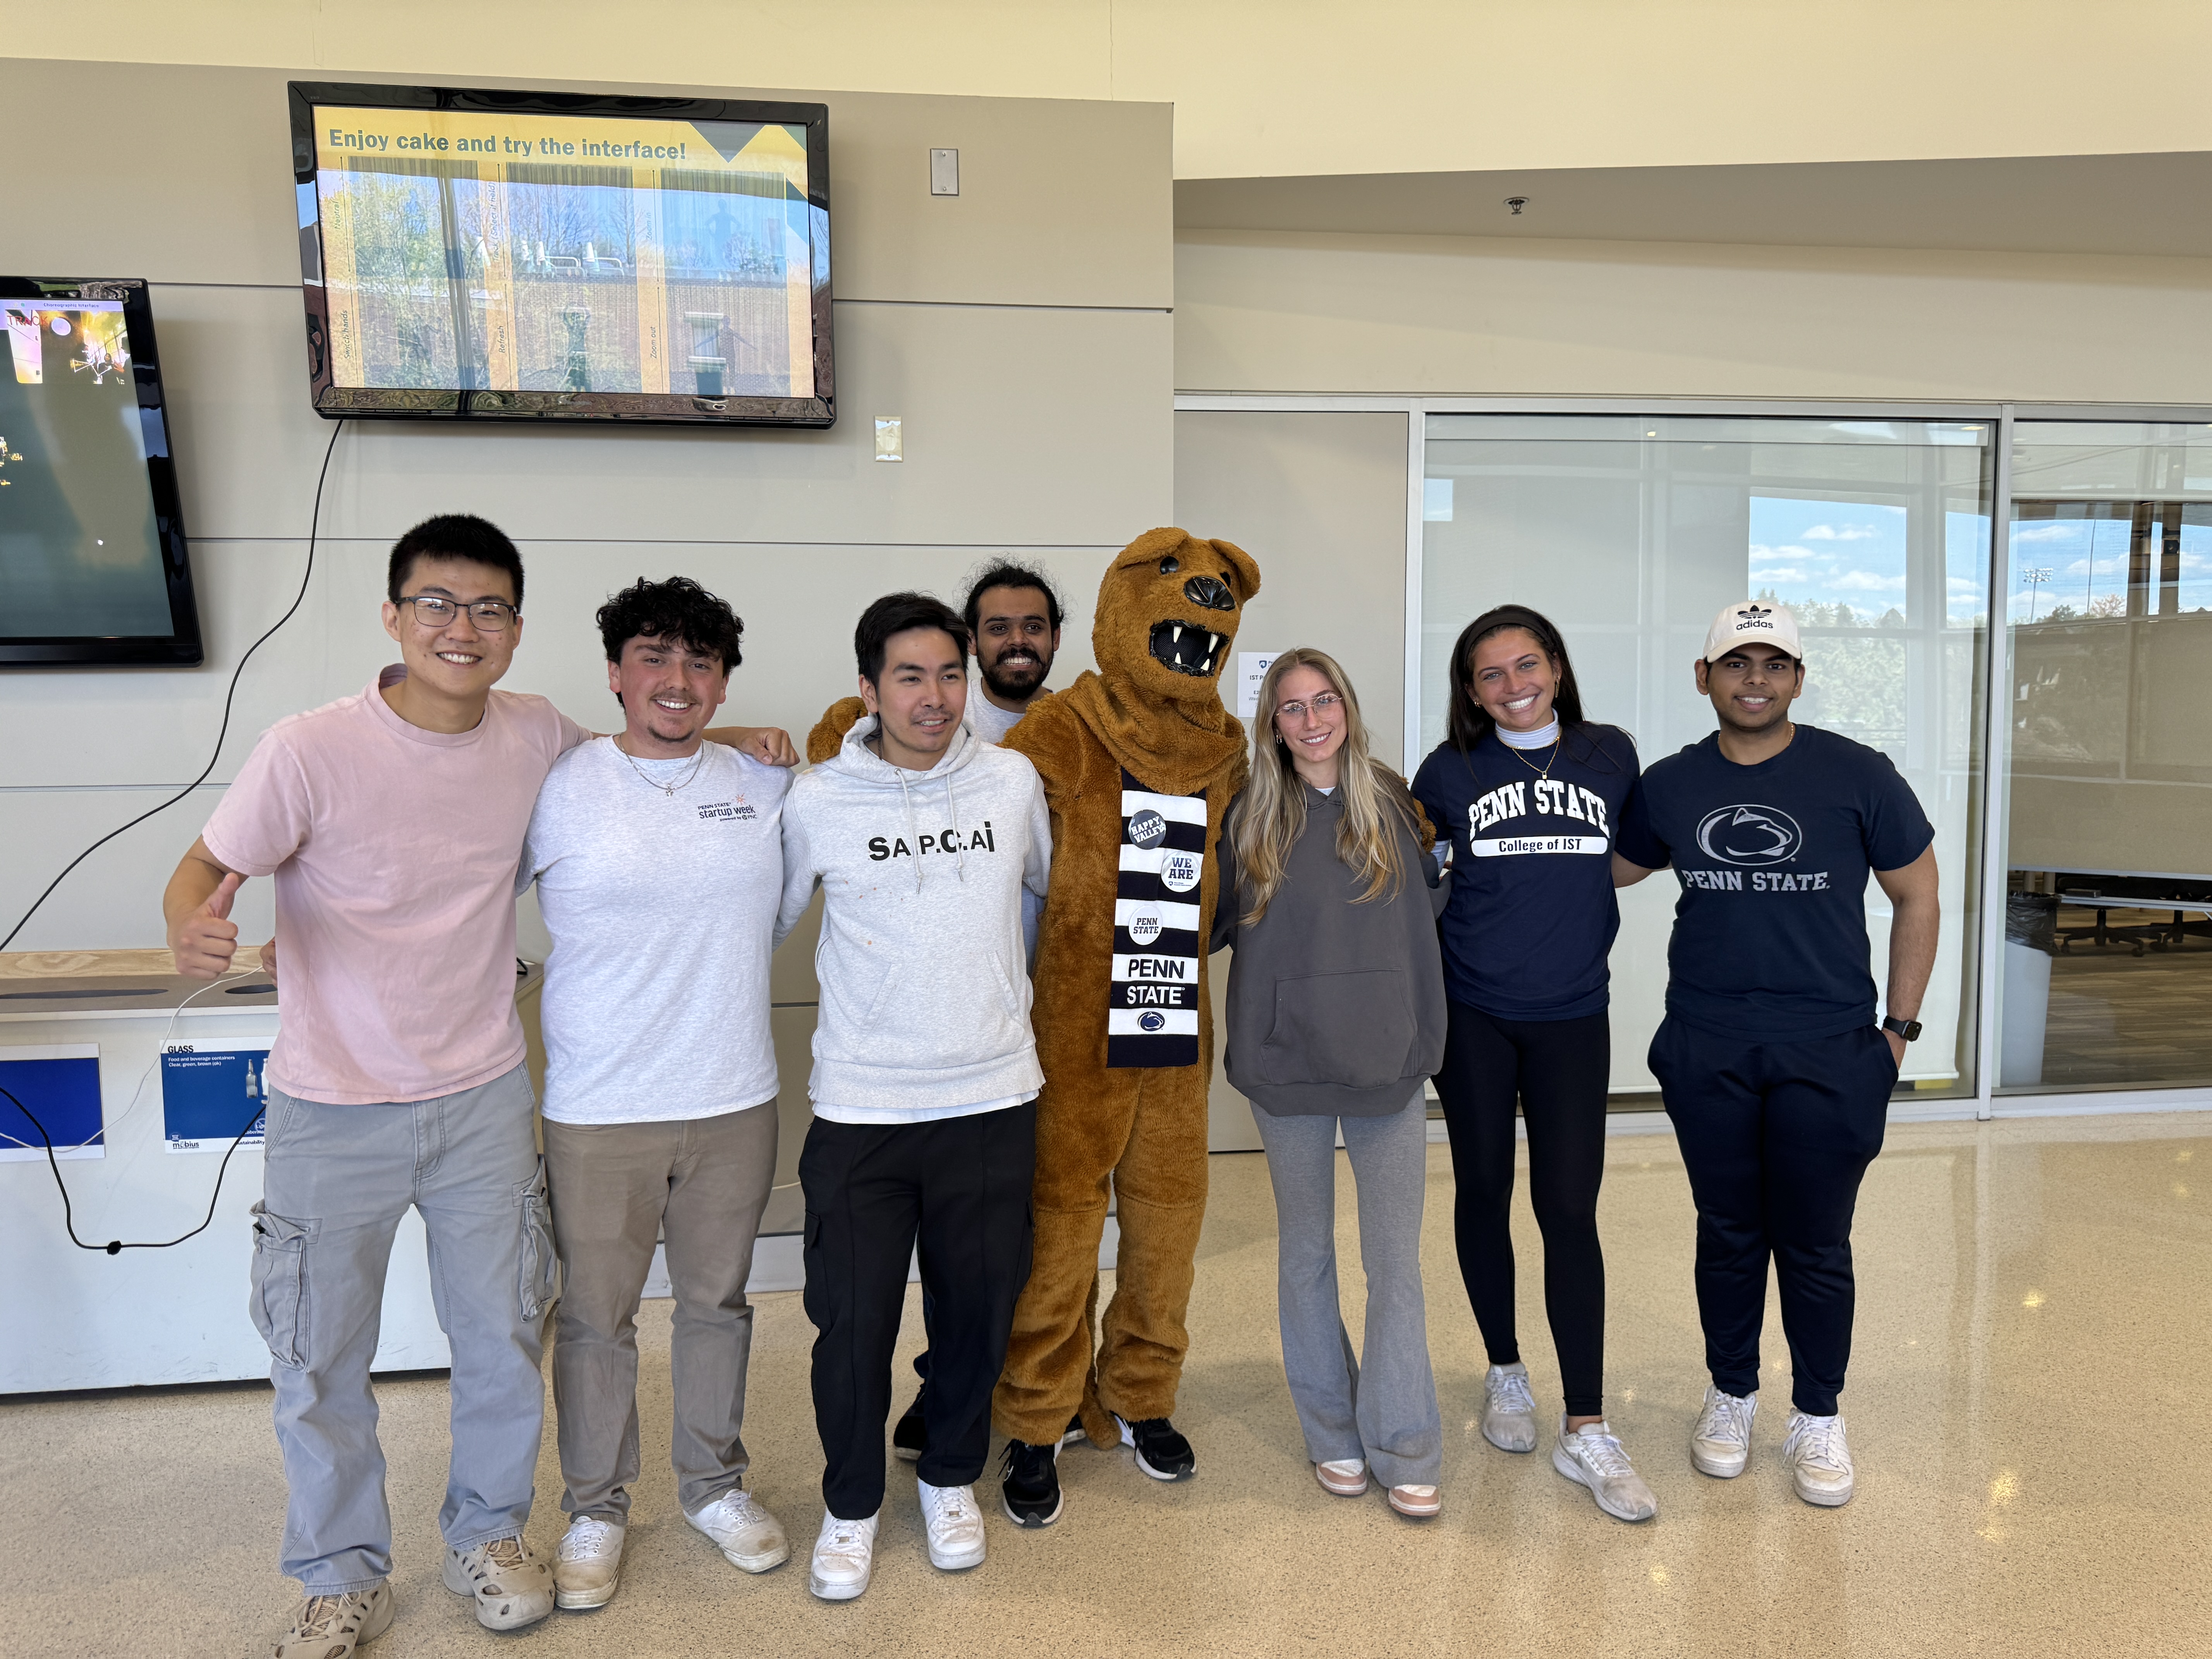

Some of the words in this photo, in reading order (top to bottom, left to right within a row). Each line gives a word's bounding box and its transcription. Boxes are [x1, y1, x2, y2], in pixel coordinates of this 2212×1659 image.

[329, 129, 389, 151] Enjoy
[396, 133, 449, 151] cake
[457, 136, 496, 152] and
[503, 136, 532, 156] try
[539, 138, 575, 155] the
[582, 139, 685, 160] interface!
[332, 200, 341, 229] Neutral
[7, 316, 50, 326] TRACK
[343, 335, 351, 360] Switch
[498, 326, 506, 353] Refresh
[1736, 620, 1774, 630] adidas
[699, 807, 732, 819] startup
[733, 805, 756, 815] week
[1468, 781, 1526, 842] PENN
[1534, 780, 1610, 839] STATE
[1131, 816, 1159, 835] HAPPY
[1133, 821, 1165, 843] VALLEY
[1499, 840, 1543, 852] College
[1547, 839, 1559, 850] of
[1563, 838, 1582, 850] IST
[1171, 857, 1192, 868] WE
[1168, 869, 1194, 879] ARE
[1681, 870, 1743, 891] PENN
[1128, 958, 1185, 979] PENN
[168, 1045, 194, 1054] GLASS
